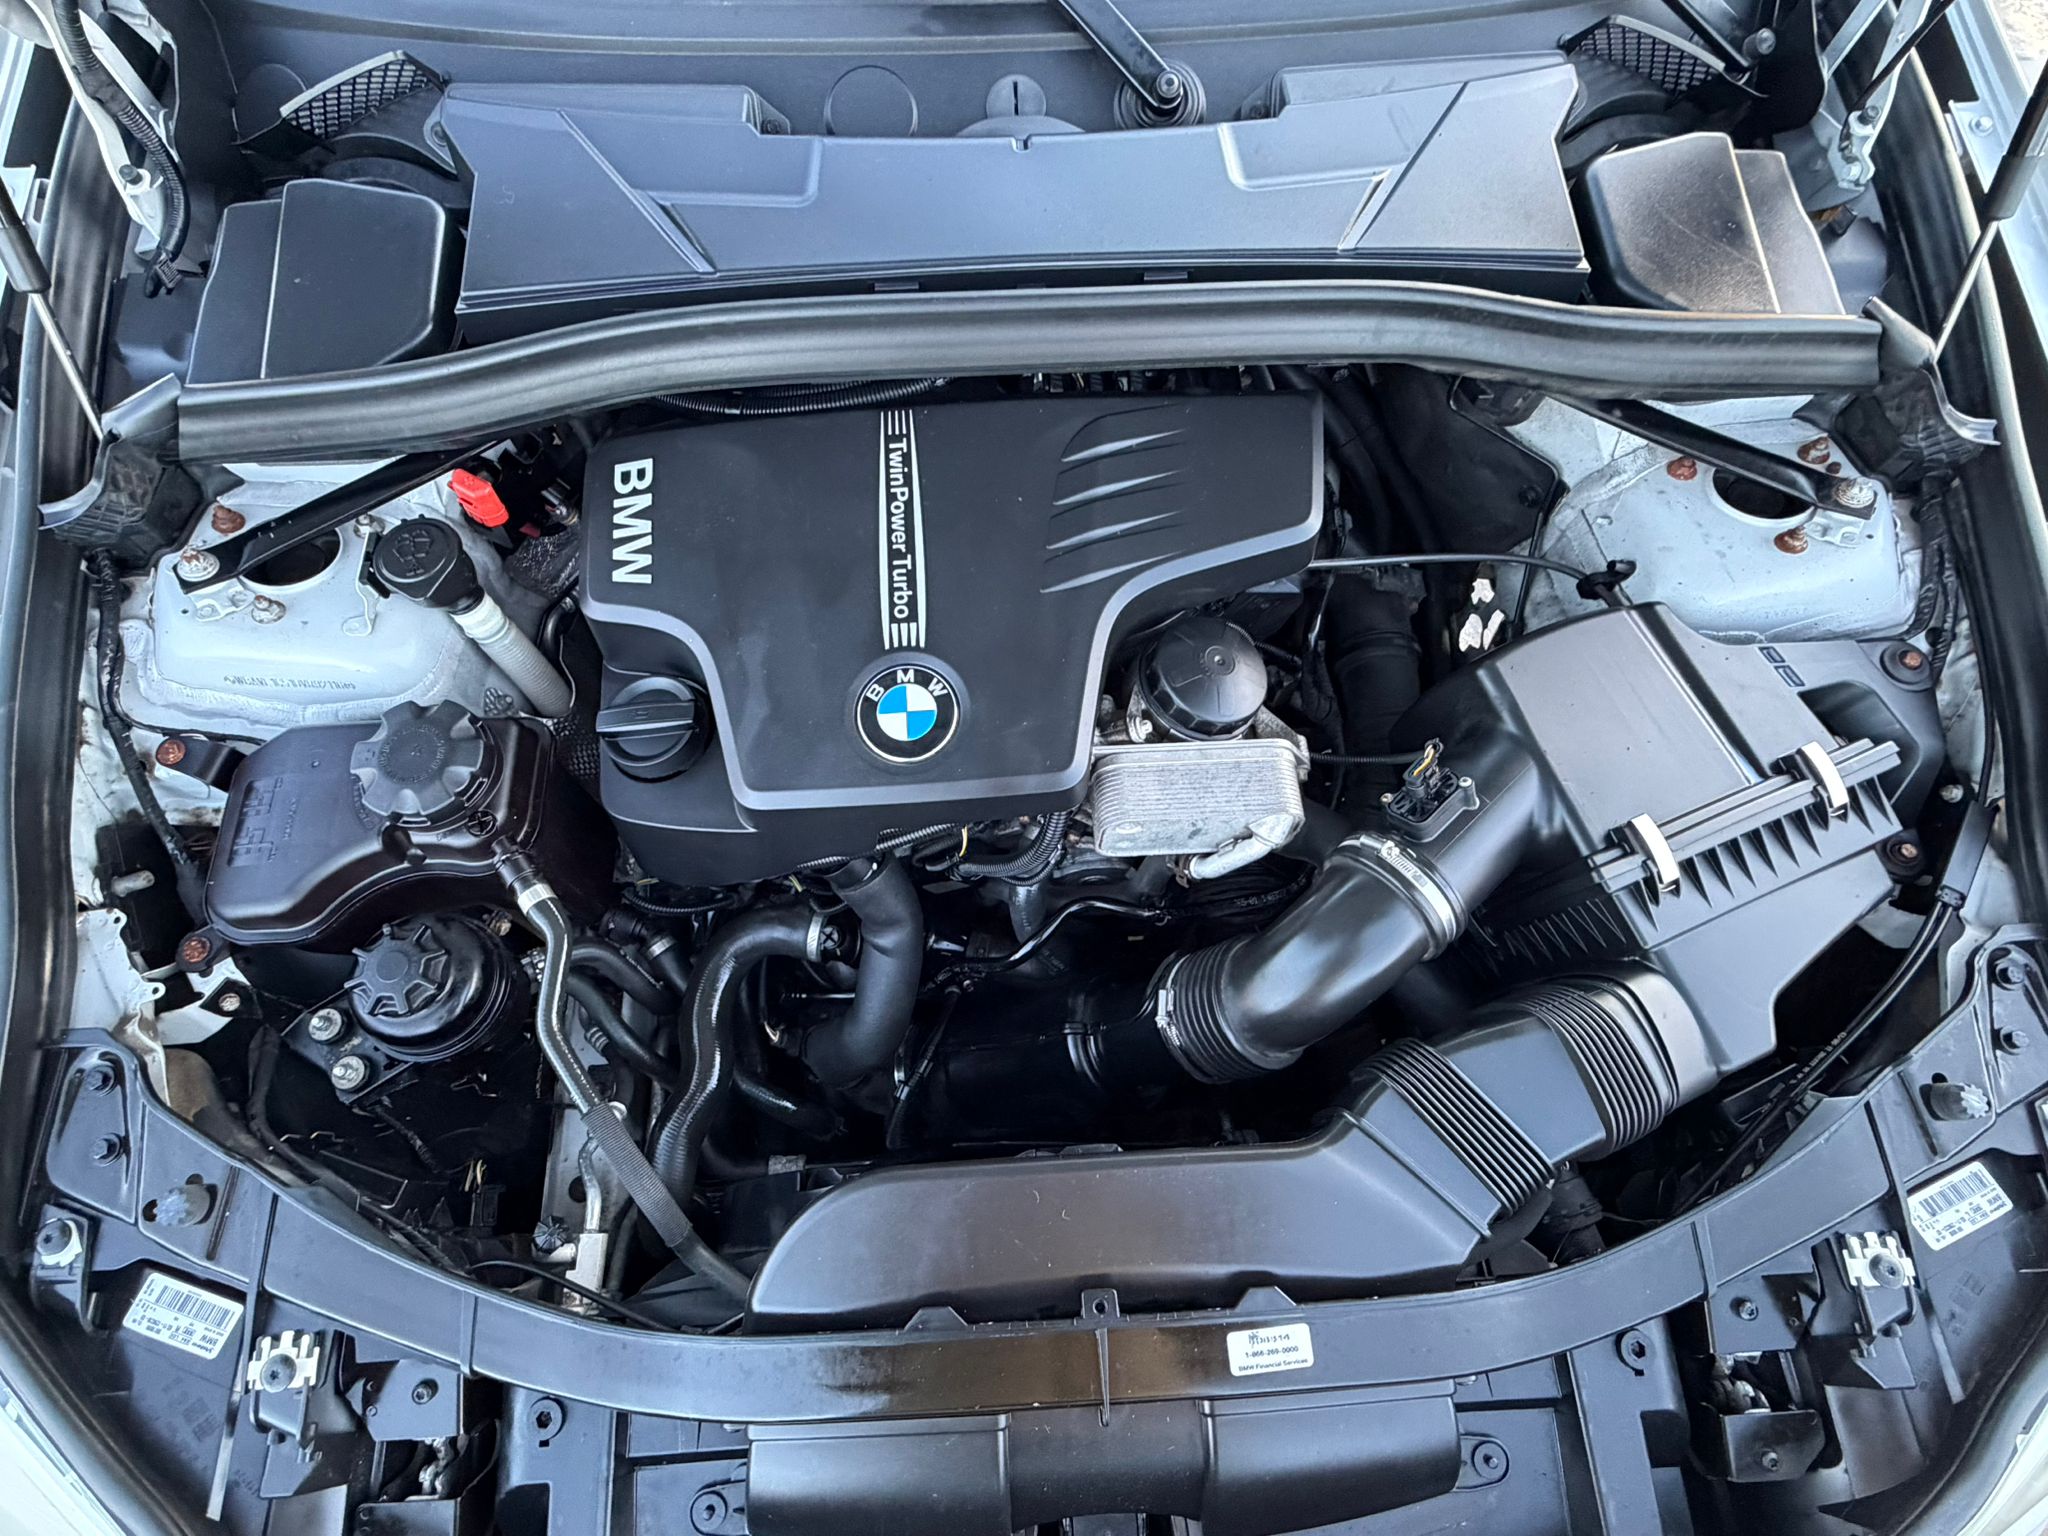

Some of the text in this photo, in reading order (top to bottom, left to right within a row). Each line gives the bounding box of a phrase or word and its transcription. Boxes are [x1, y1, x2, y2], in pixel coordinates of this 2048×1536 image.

[611, 457, 654, 585] BMW
[889, 438, 912, 618] TwinPower Turbo
[866, 669, 949, 702] BMW
[1255, 1360, 1282, 1370] Financial
[1282, 1357, 1309, 1367] Services
